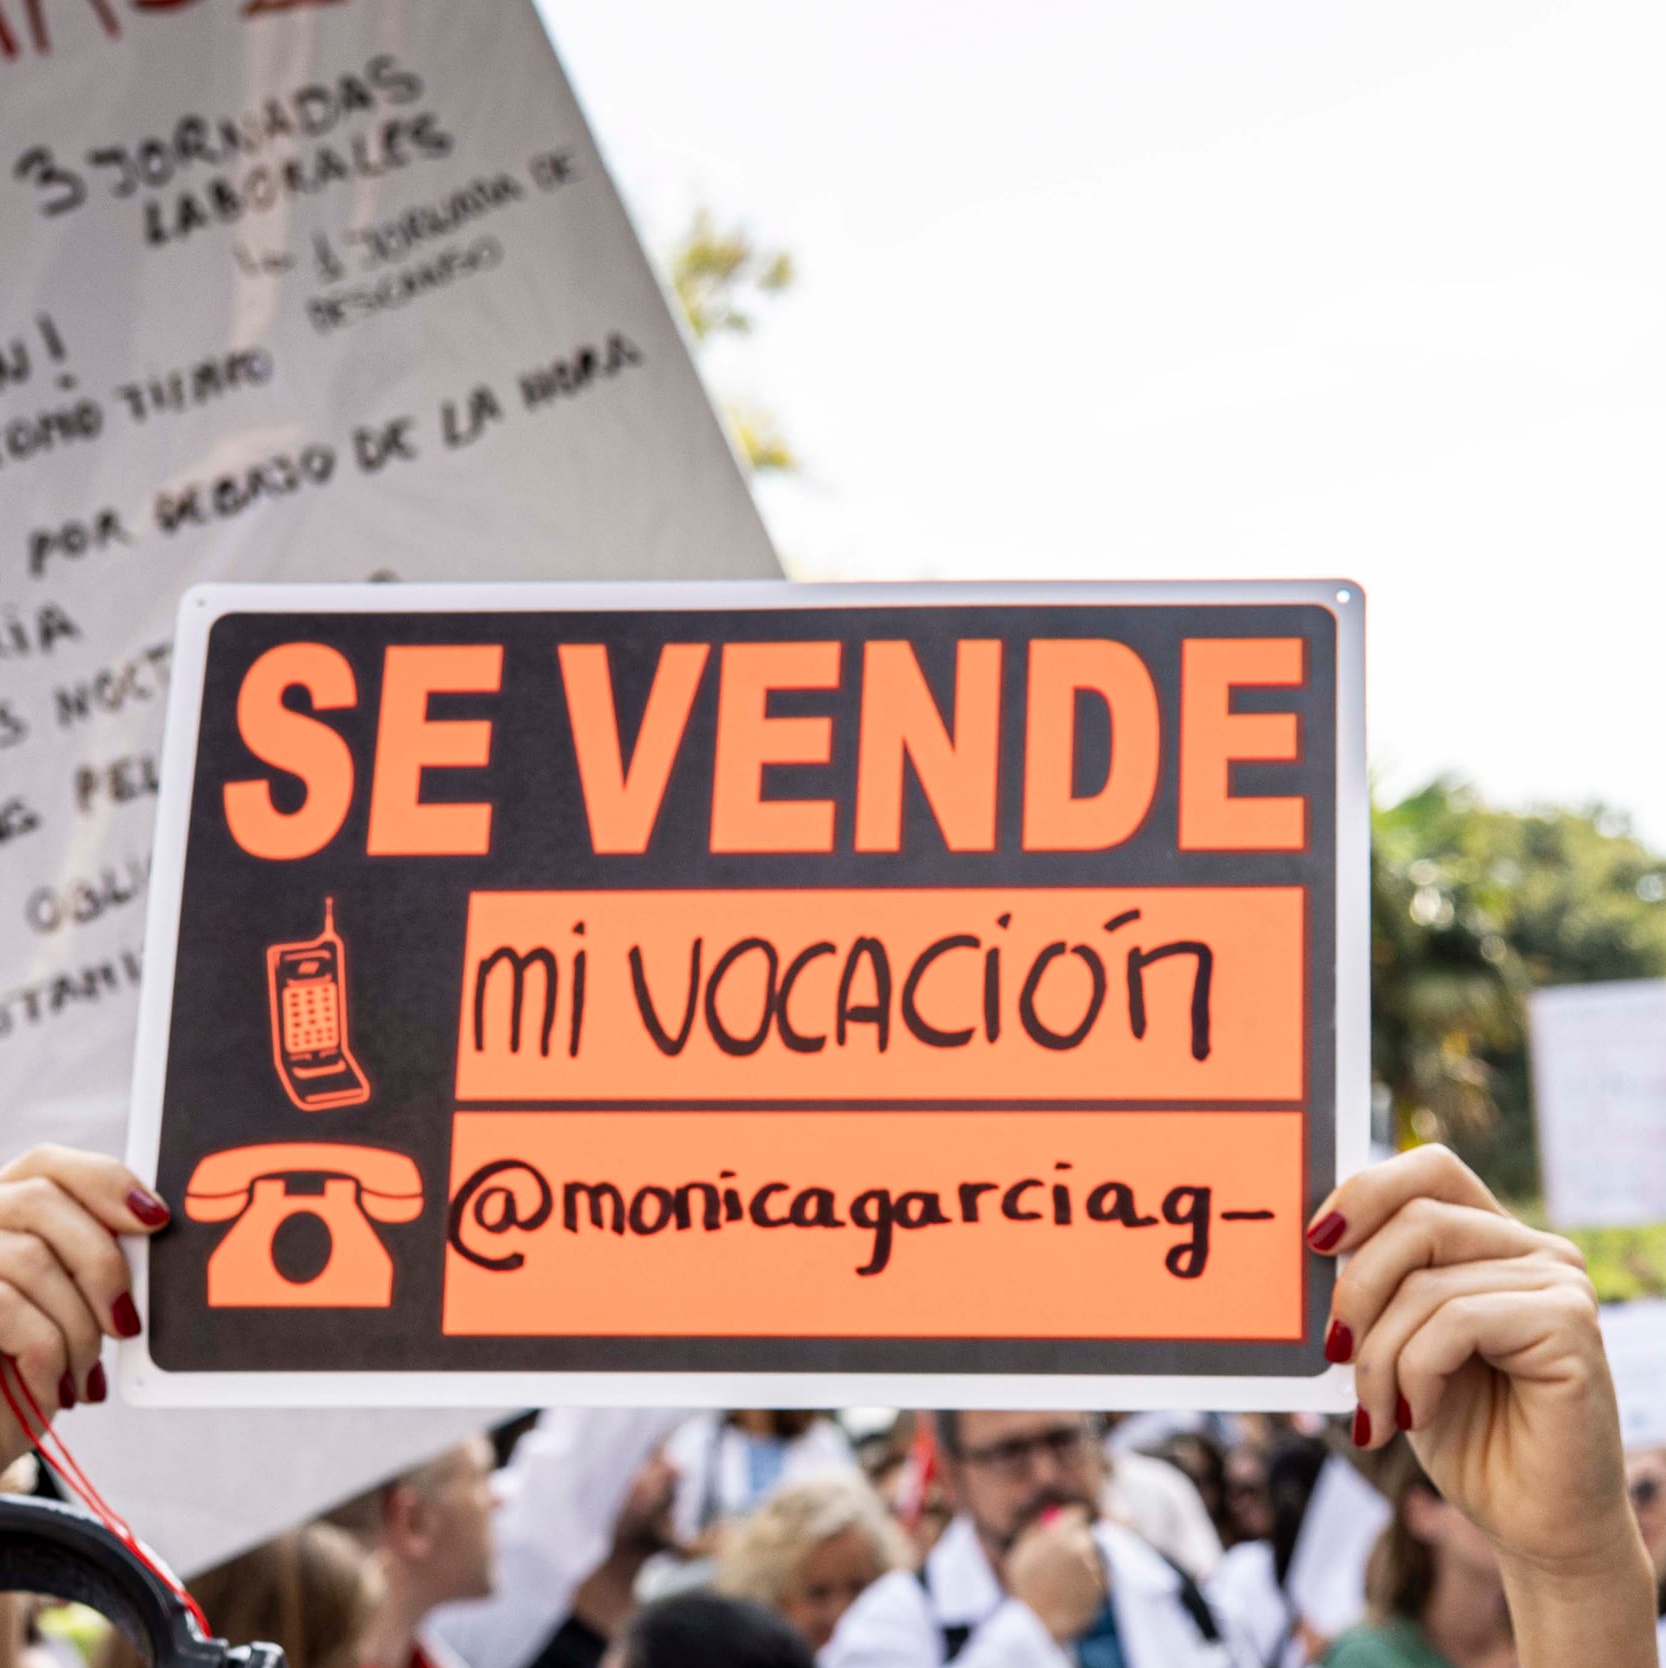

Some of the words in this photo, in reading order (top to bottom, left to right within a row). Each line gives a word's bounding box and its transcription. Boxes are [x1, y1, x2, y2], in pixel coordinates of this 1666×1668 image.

[14, 145, 87, 218] 3
[87, 53, 424, 199] JORNADAS
[28, 505, 135, 580] POR
[352, 415, 418, 474] DE
[440, 384, 506, 450] LA
[223, 641, 504, 860] SE
[558, 636, 1306, 855] VENDE
